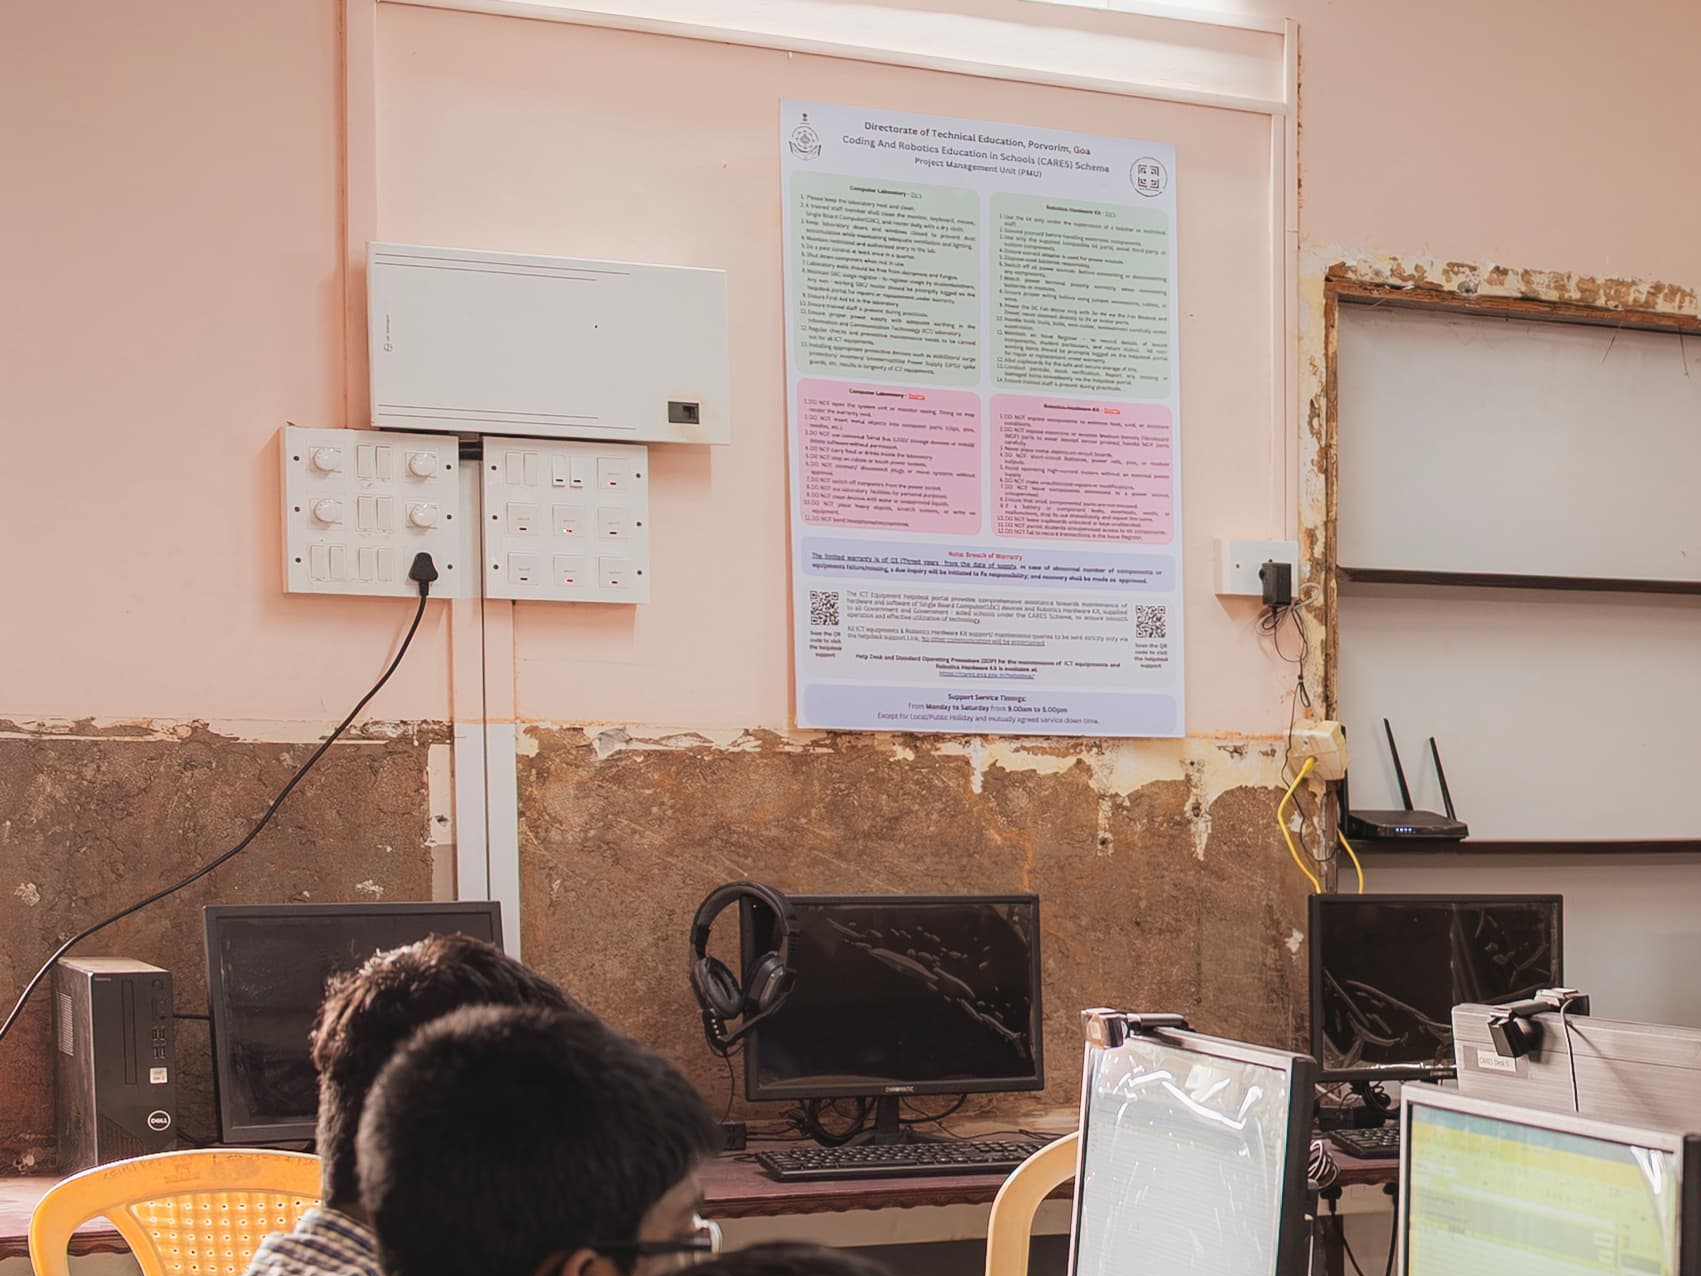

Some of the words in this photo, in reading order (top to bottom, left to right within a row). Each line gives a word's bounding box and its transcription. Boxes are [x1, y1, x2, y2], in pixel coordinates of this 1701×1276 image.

[864, 122, 917, 135] Directorate
[920, 127, 929, 136] of
[932, 129, 975, 142] Technical
[978, 135, 1025, 147] Education,
[1028, 140, 1070, 152] Porvorim,
[1073, 146, 1090, 155] Goa
[842, 135, 875, 147] Coding
[877, 139, 896, 149] And
[898, 142, 939, 153] Robotics
[941, 146, 987, 159] Education
[1000, 153, 1035, 164] Schools
[1037, 157, 1072, 168] (CARES)
[1075, 162, 1109, 173] Scheme
[914, 157, 944, 167] Project
[945, 161, 997, 173] Management
[999, 166, 1016, 175] Unit
[1017, 168, 1041, 177] (PMU)
[150, 1117, 168, 1125] DELL
